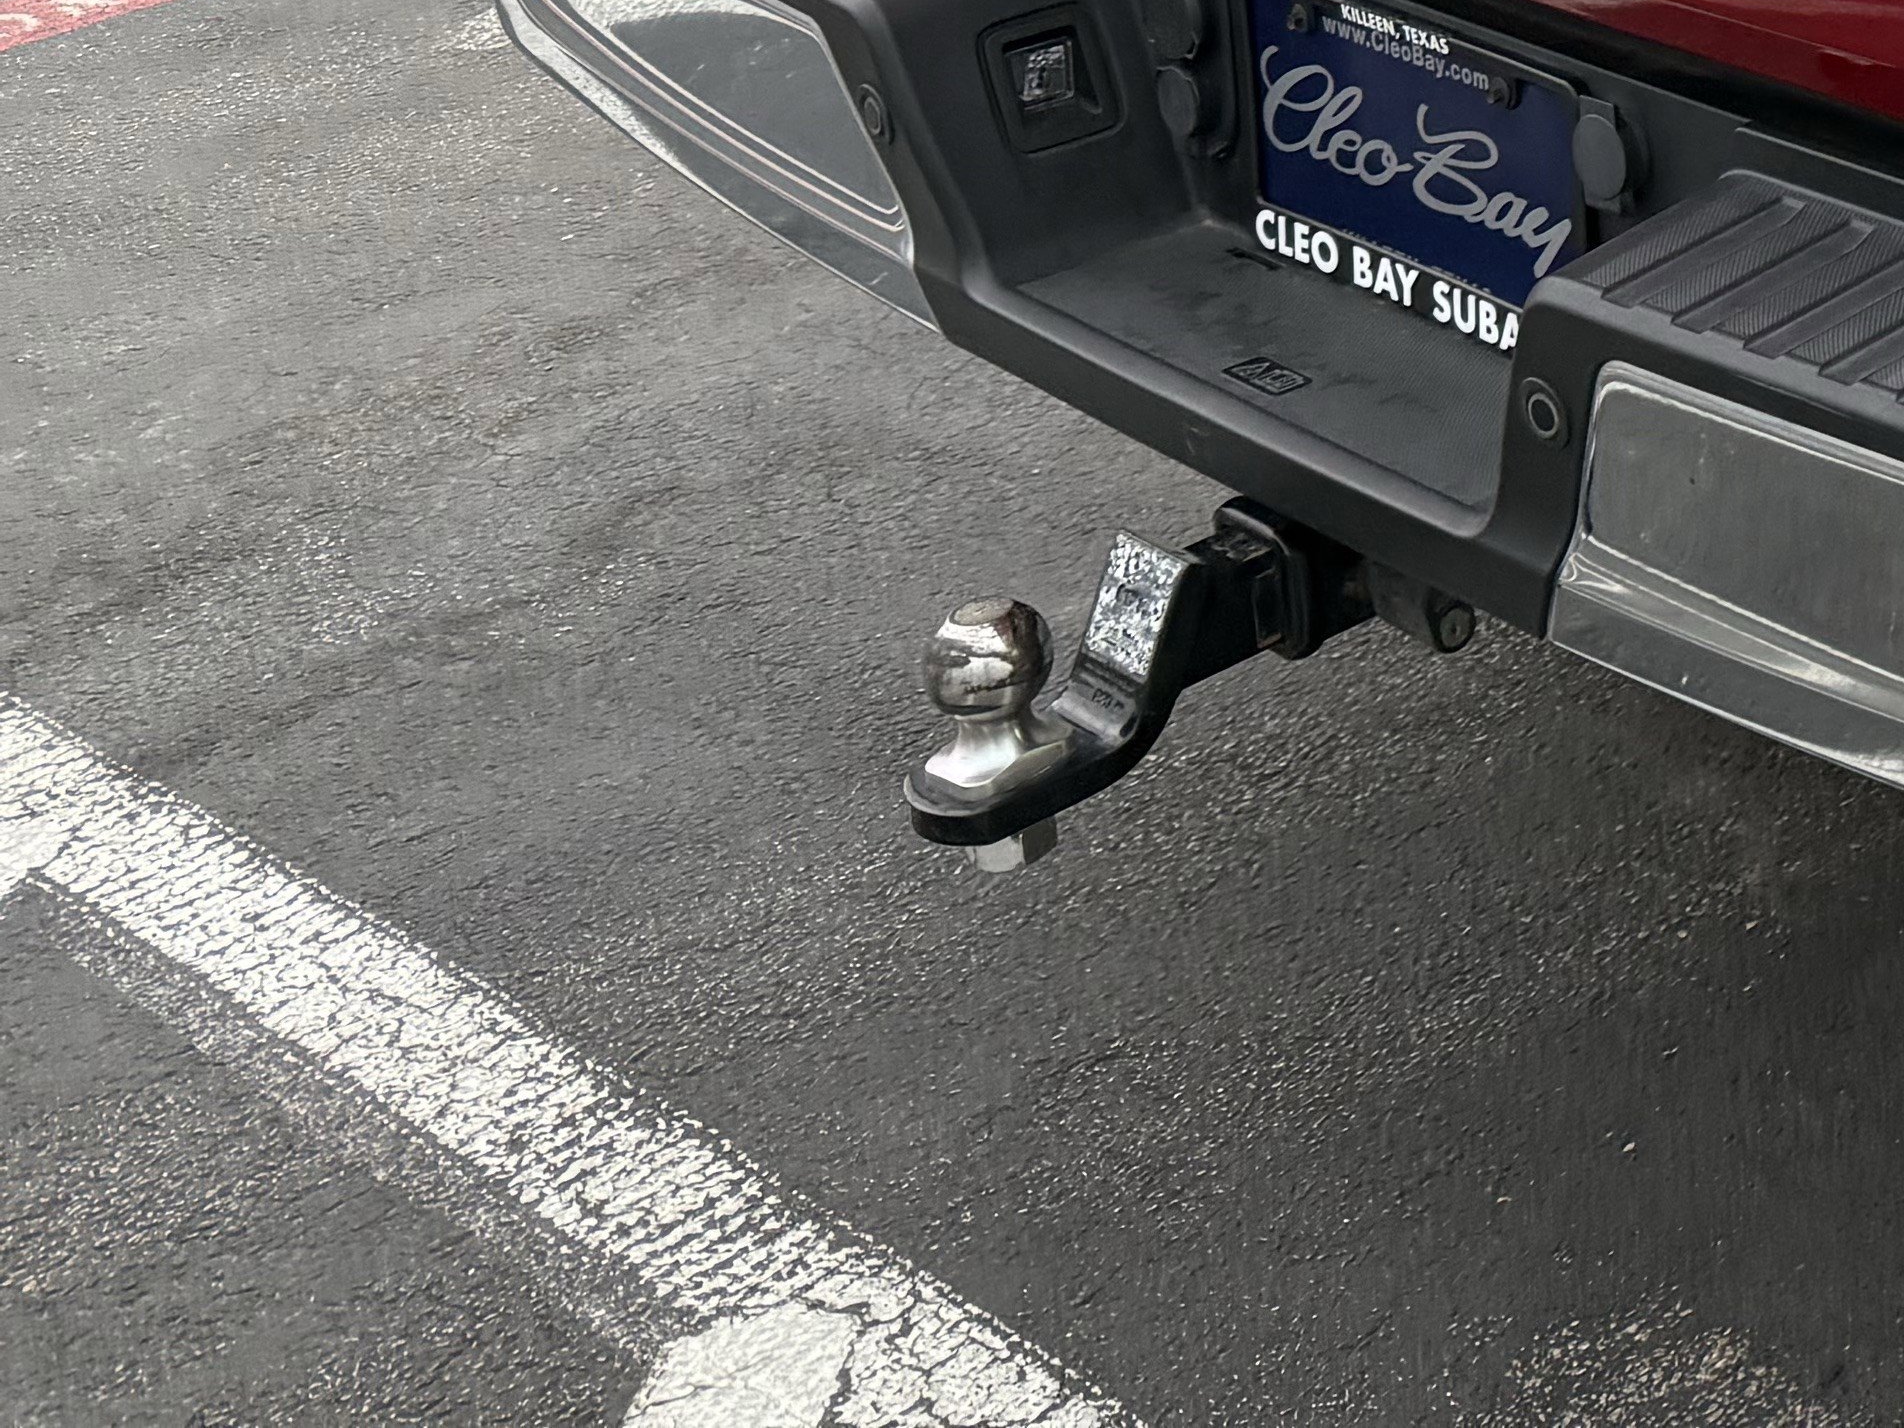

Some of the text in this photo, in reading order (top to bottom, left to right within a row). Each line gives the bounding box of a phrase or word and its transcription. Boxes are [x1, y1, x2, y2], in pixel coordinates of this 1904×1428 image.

[1322, 15, 1489, 91] www.CleoBay.com
[1340, 3, 1449, 55] KILLEEN, TEXAS
[1260, 45, 1413, 186] Cleo
[1412, 103, 1572, 278] Bay
[1255, 209, 1338, 274] CLEO
[1353, 245, 1419, 307] BAY
